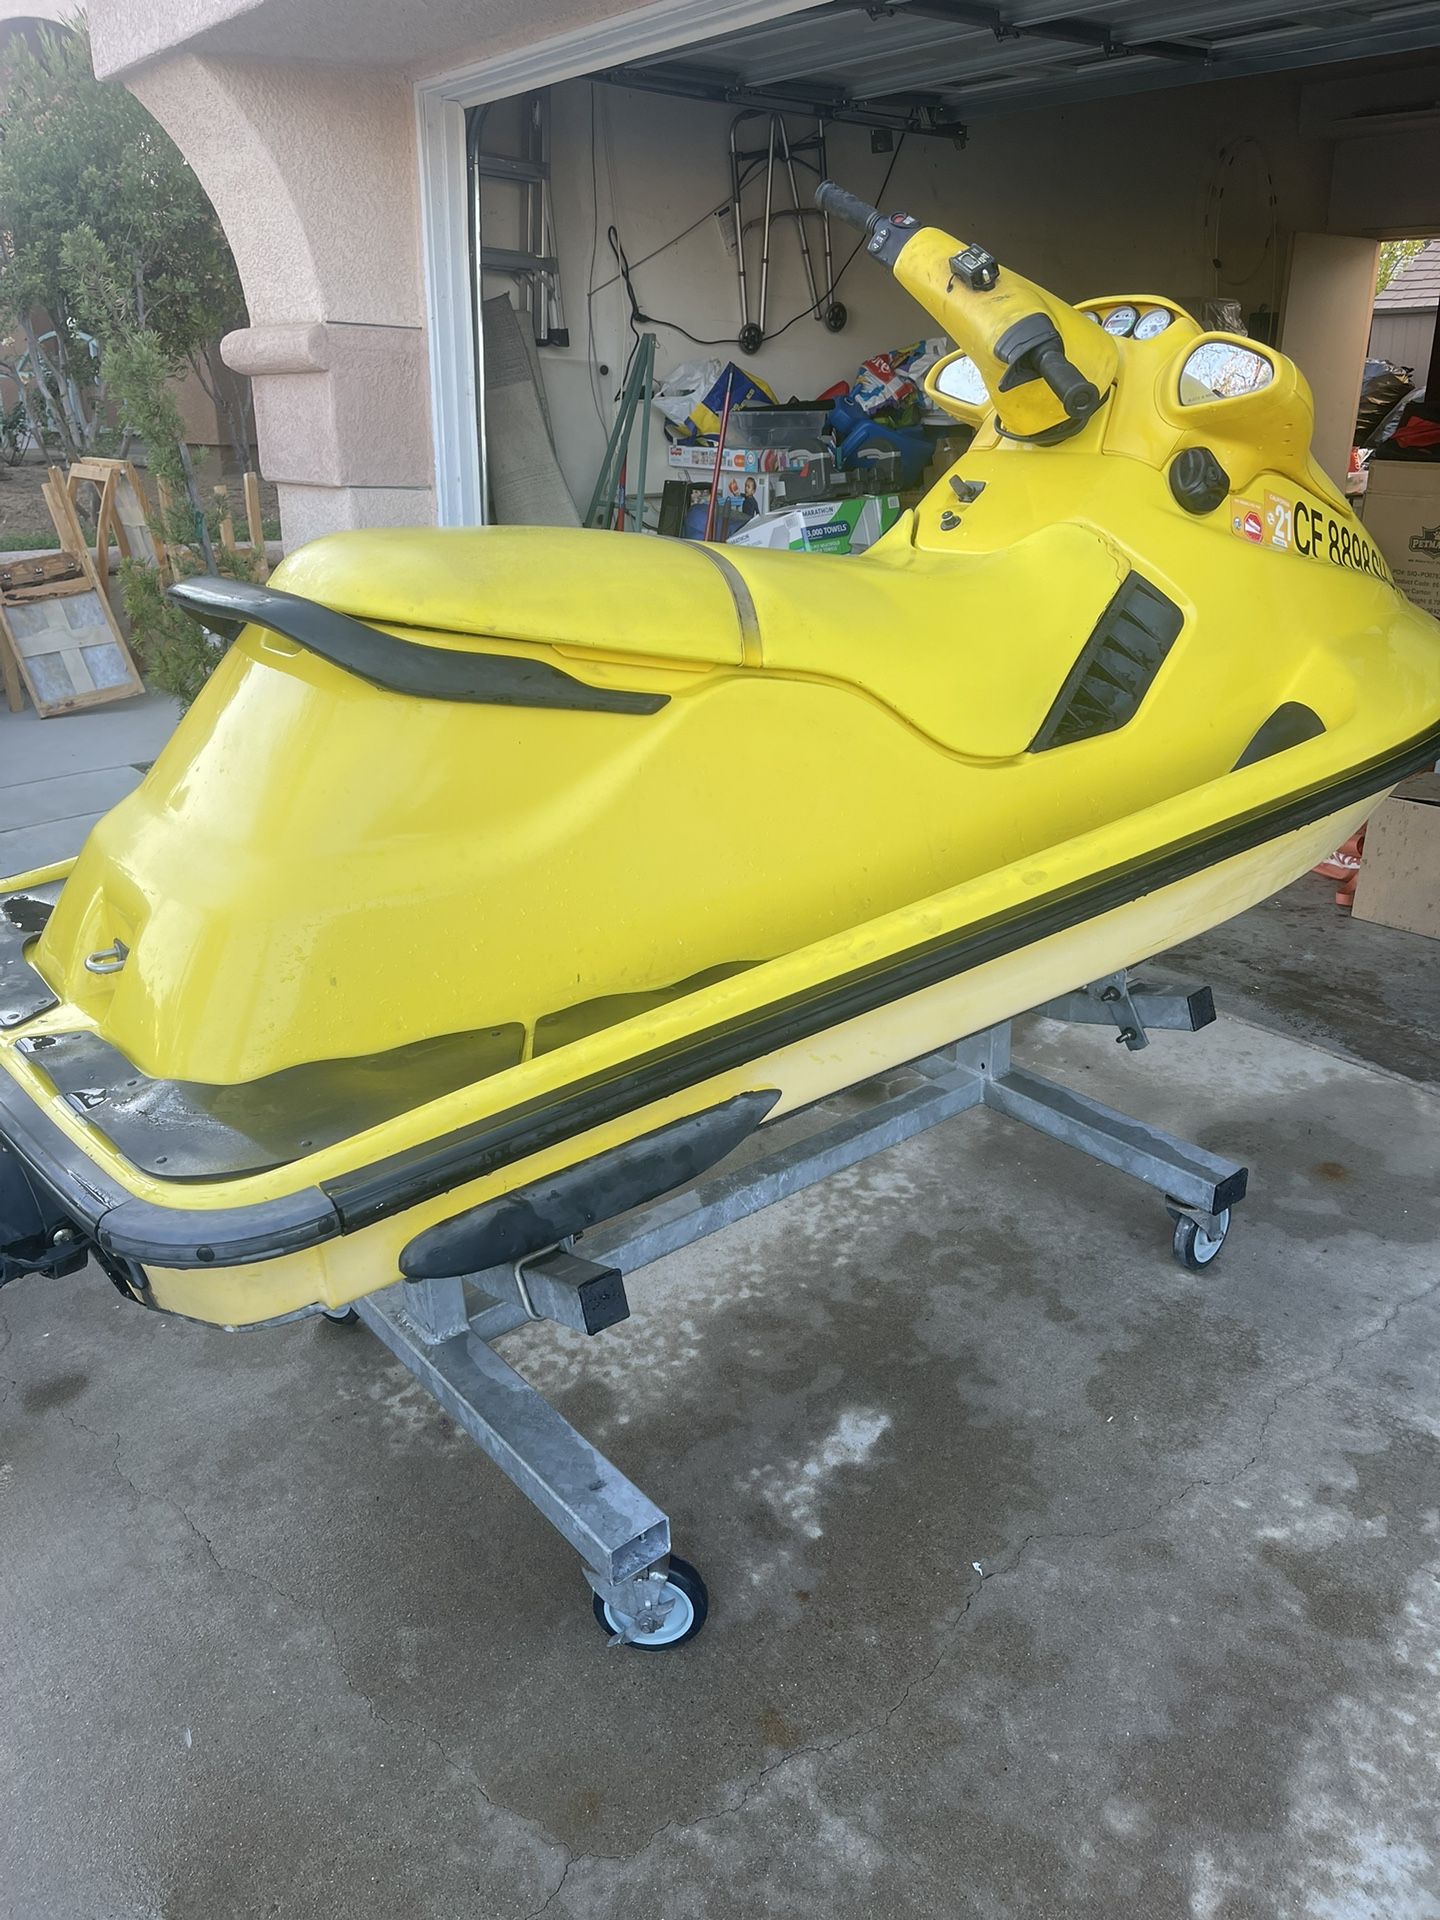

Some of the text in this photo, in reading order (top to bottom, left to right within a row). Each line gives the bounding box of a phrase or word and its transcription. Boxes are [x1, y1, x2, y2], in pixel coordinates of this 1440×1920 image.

[802, 506, 834, 516] MARATHON
[1275, 504, 1292, 542] 21
[806, 523, 848, 538] 3,000 TOWELS
[1293, 501, 1323, 558] CF
